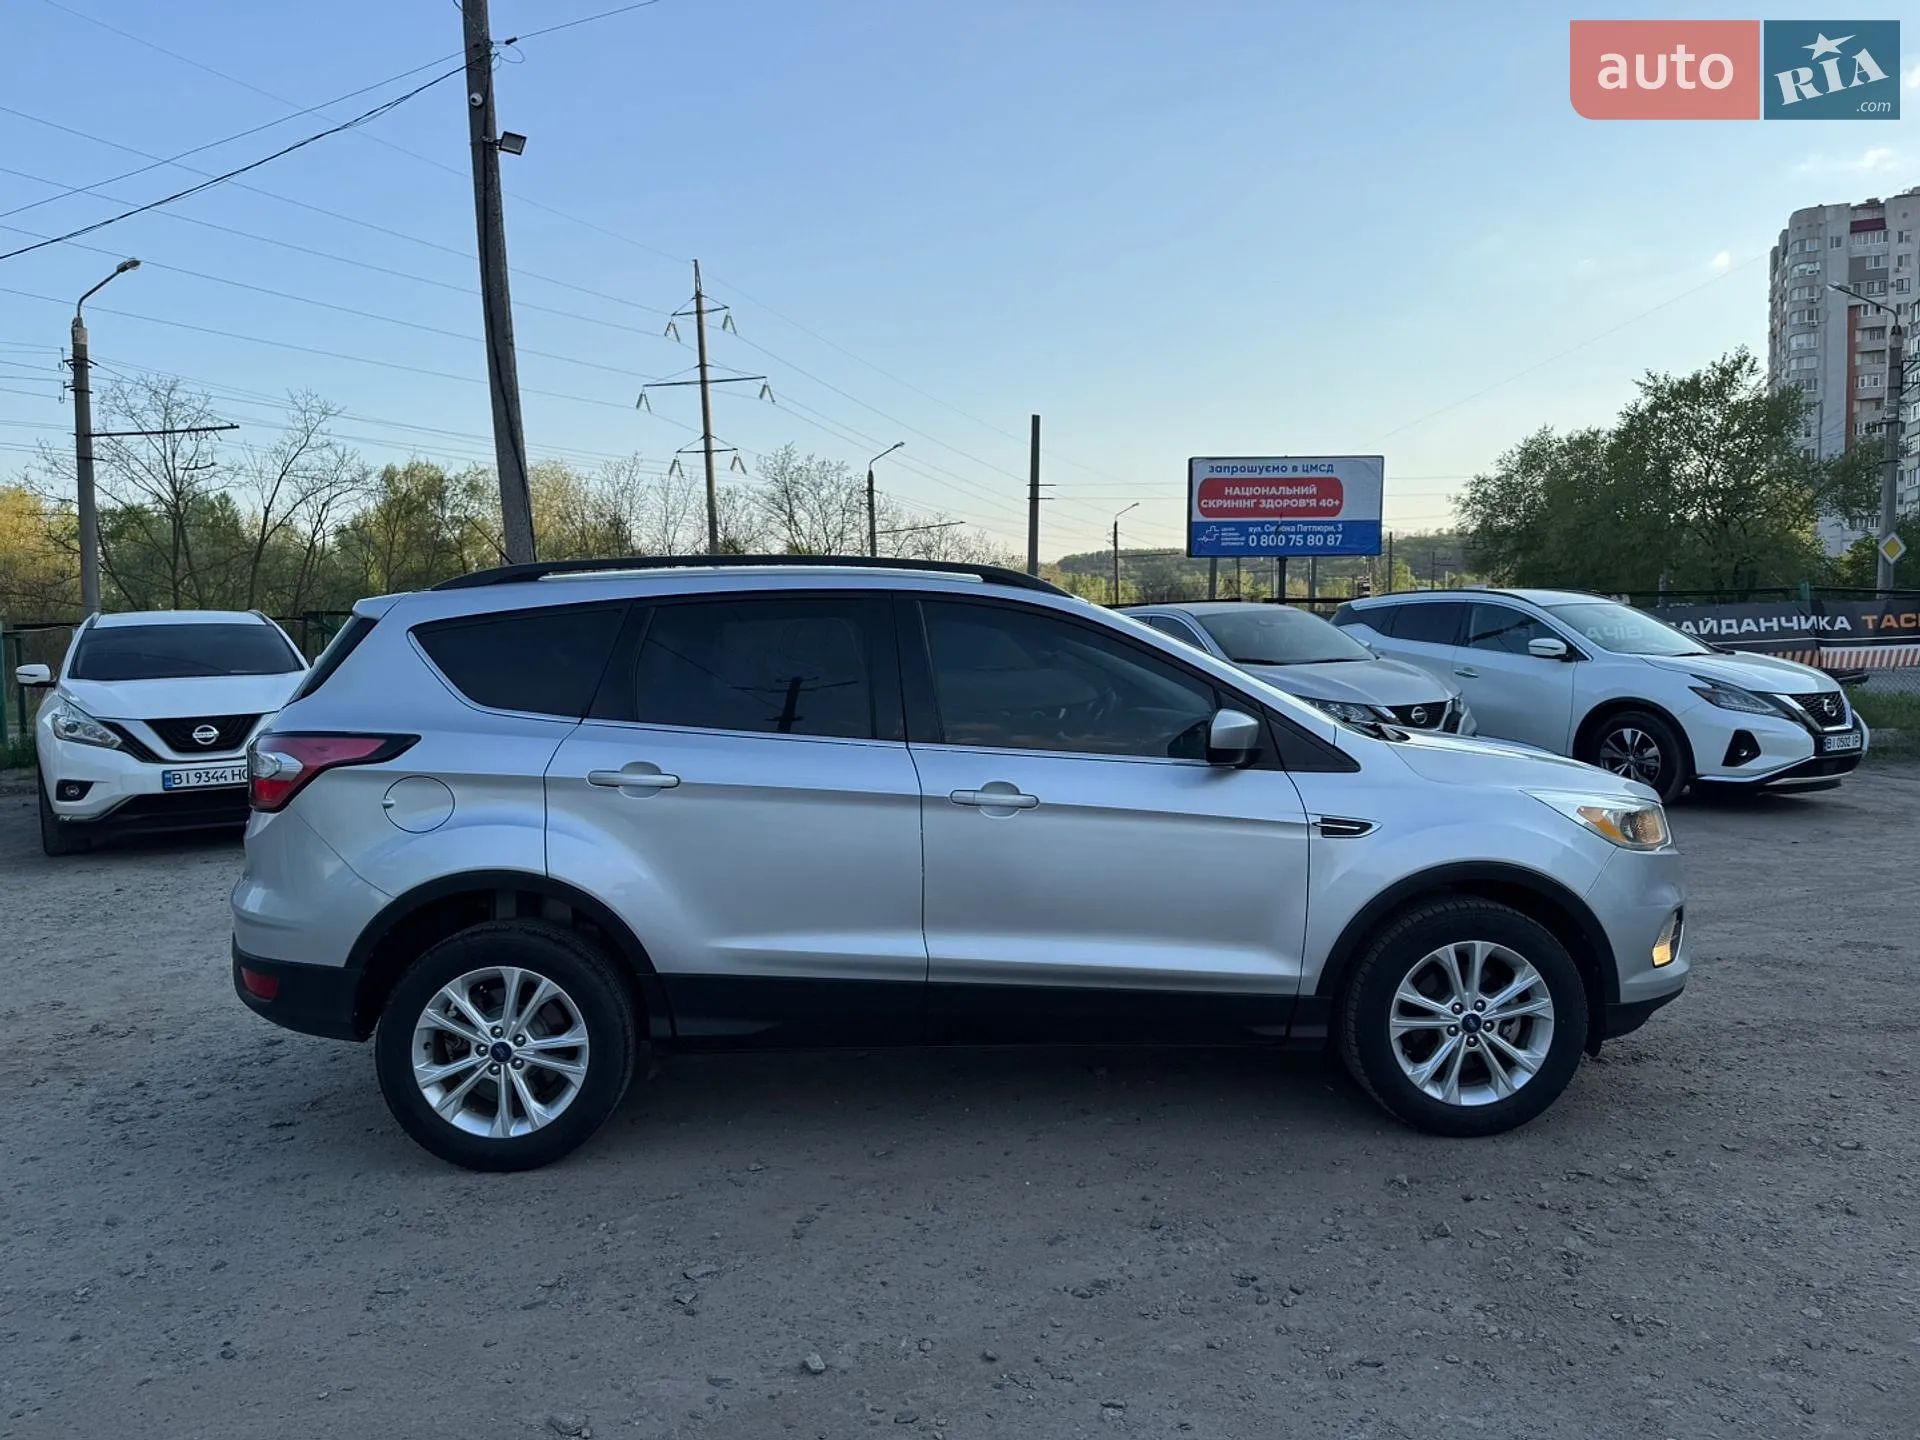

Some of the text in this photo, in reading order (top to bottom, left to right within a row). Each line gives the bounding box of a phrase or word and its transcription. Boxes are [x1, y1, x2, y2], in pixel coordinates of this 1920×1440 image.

[1208, 464, 1288, 476] запрошуємо
[1302, 464, 1335, 474] ЦМСД
[1224, 484, 1317, 497] НАЦІОНАЛЬНИЙ
[1200, 499, 1256, 509] СКРИНІНГ
[1319, 499, 1340, 508] 40+
[1249, 535, 1258, 547] 0
[1260, 534, 1287, 547] 800
[1288, 534, 1304, 546] 75
[1306, 534, 1325, 546] 80
[1327, 534, 1343, 546] 87
[1861, 613, 1920, 630] ТАС
[172, 772, 190, 785] BI
[194, 769, 228, 784] 9344
